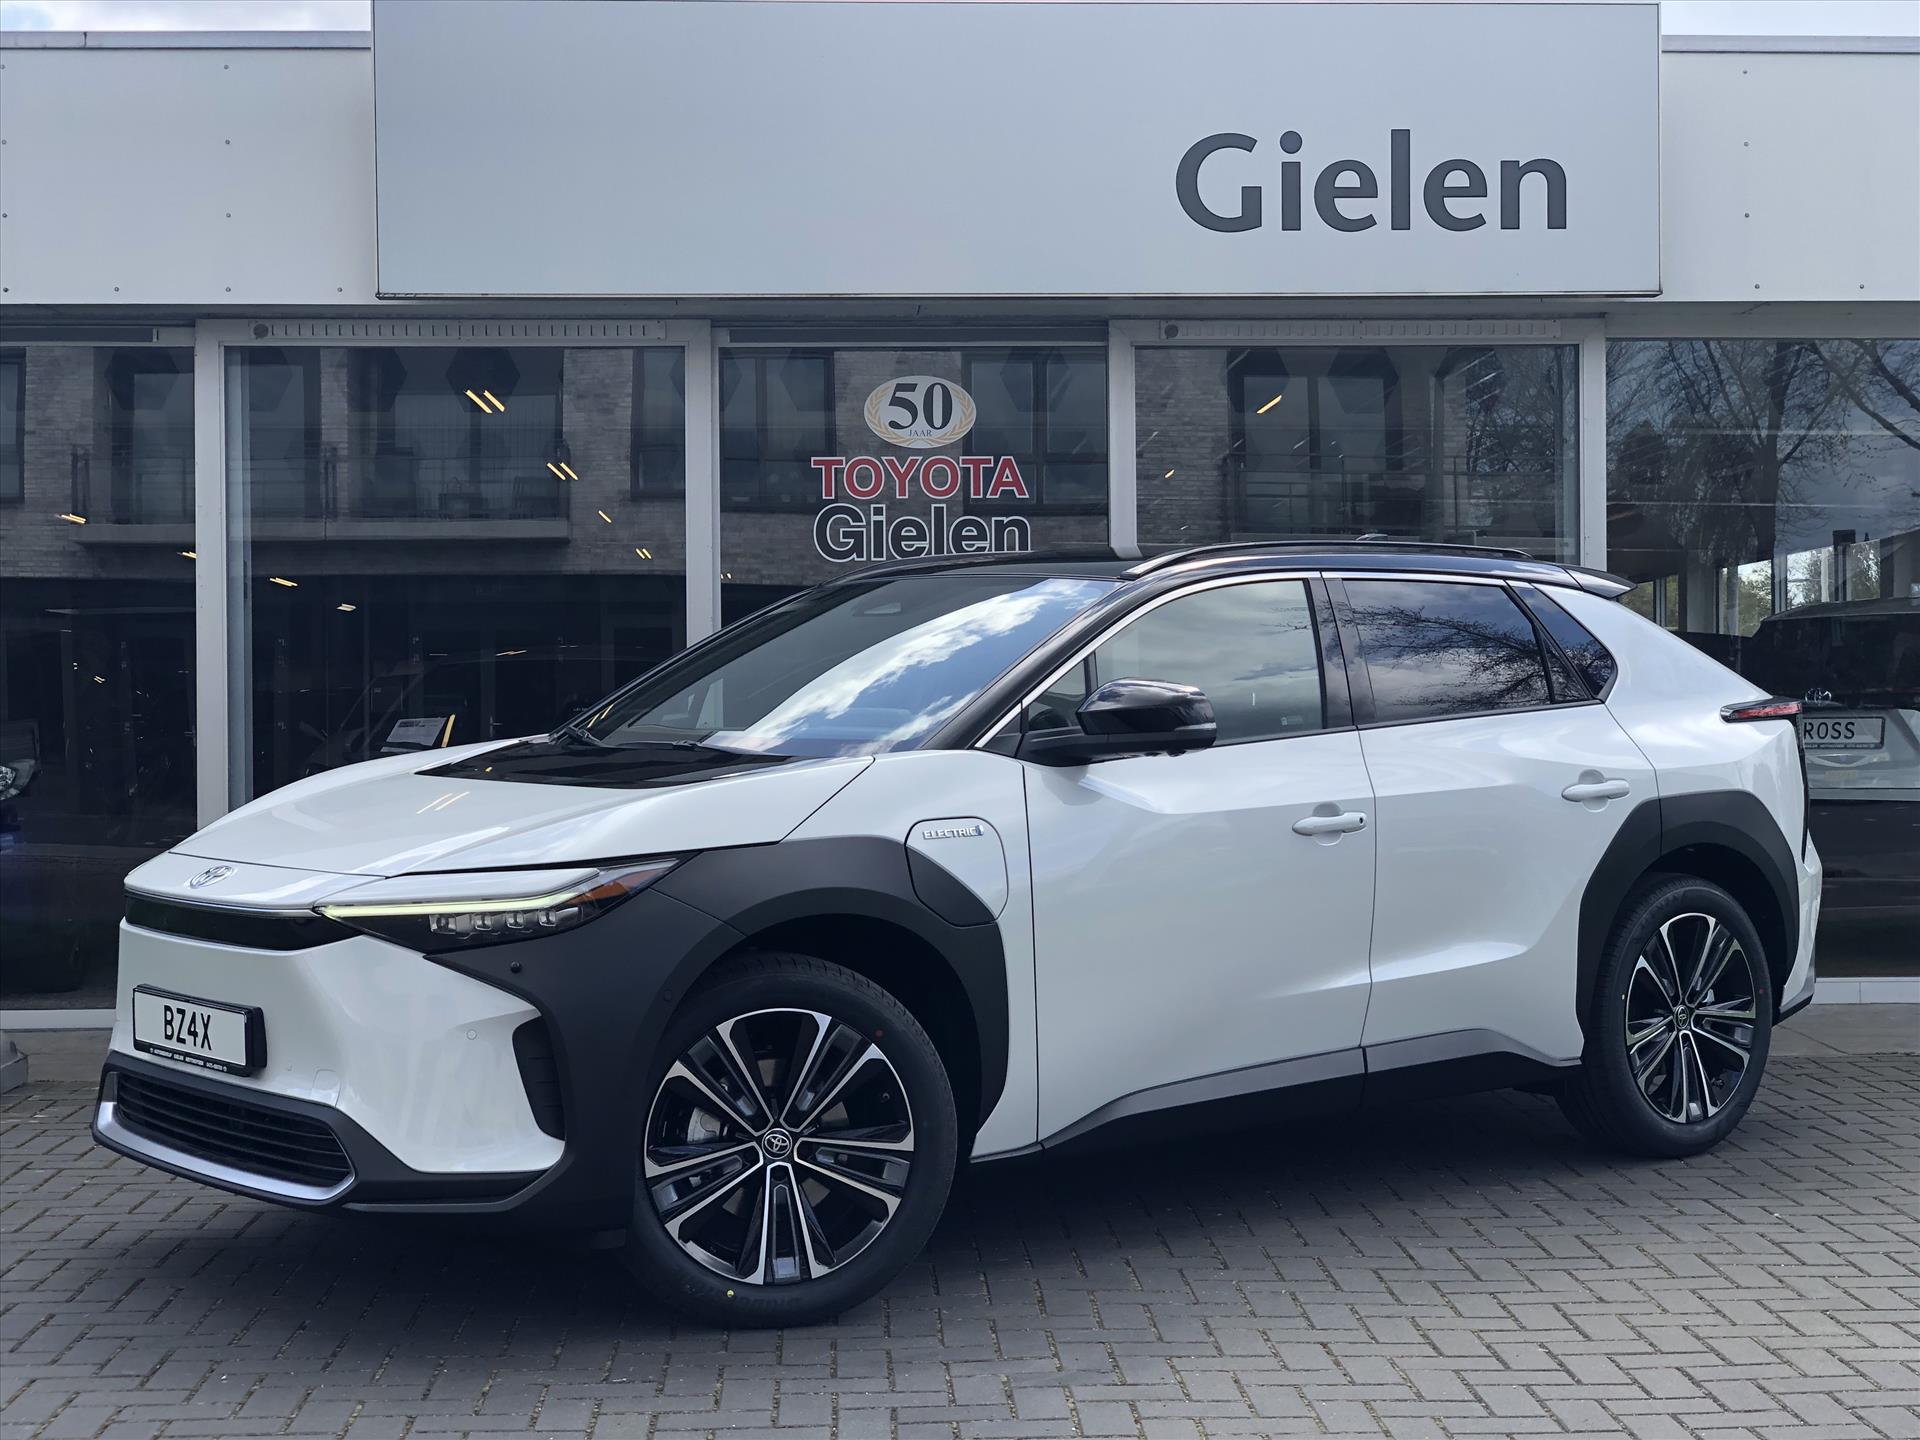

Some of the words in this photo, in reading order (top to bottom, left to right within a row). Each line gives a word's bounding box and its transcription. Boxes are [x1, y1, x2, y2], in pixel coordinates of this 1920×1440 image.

[1175, 128, 1567, 233] Gielen
[888, 382, 953, 430] 50
[908, 429, 933, 438] JAAR
[811, 455, 1029, 499] TOYOTA
[813, 503, 1031, 562] Gielen
[922, 826, 977, 840] ELECTRIC
[163, 1004, 212, 1051] BZ4X
